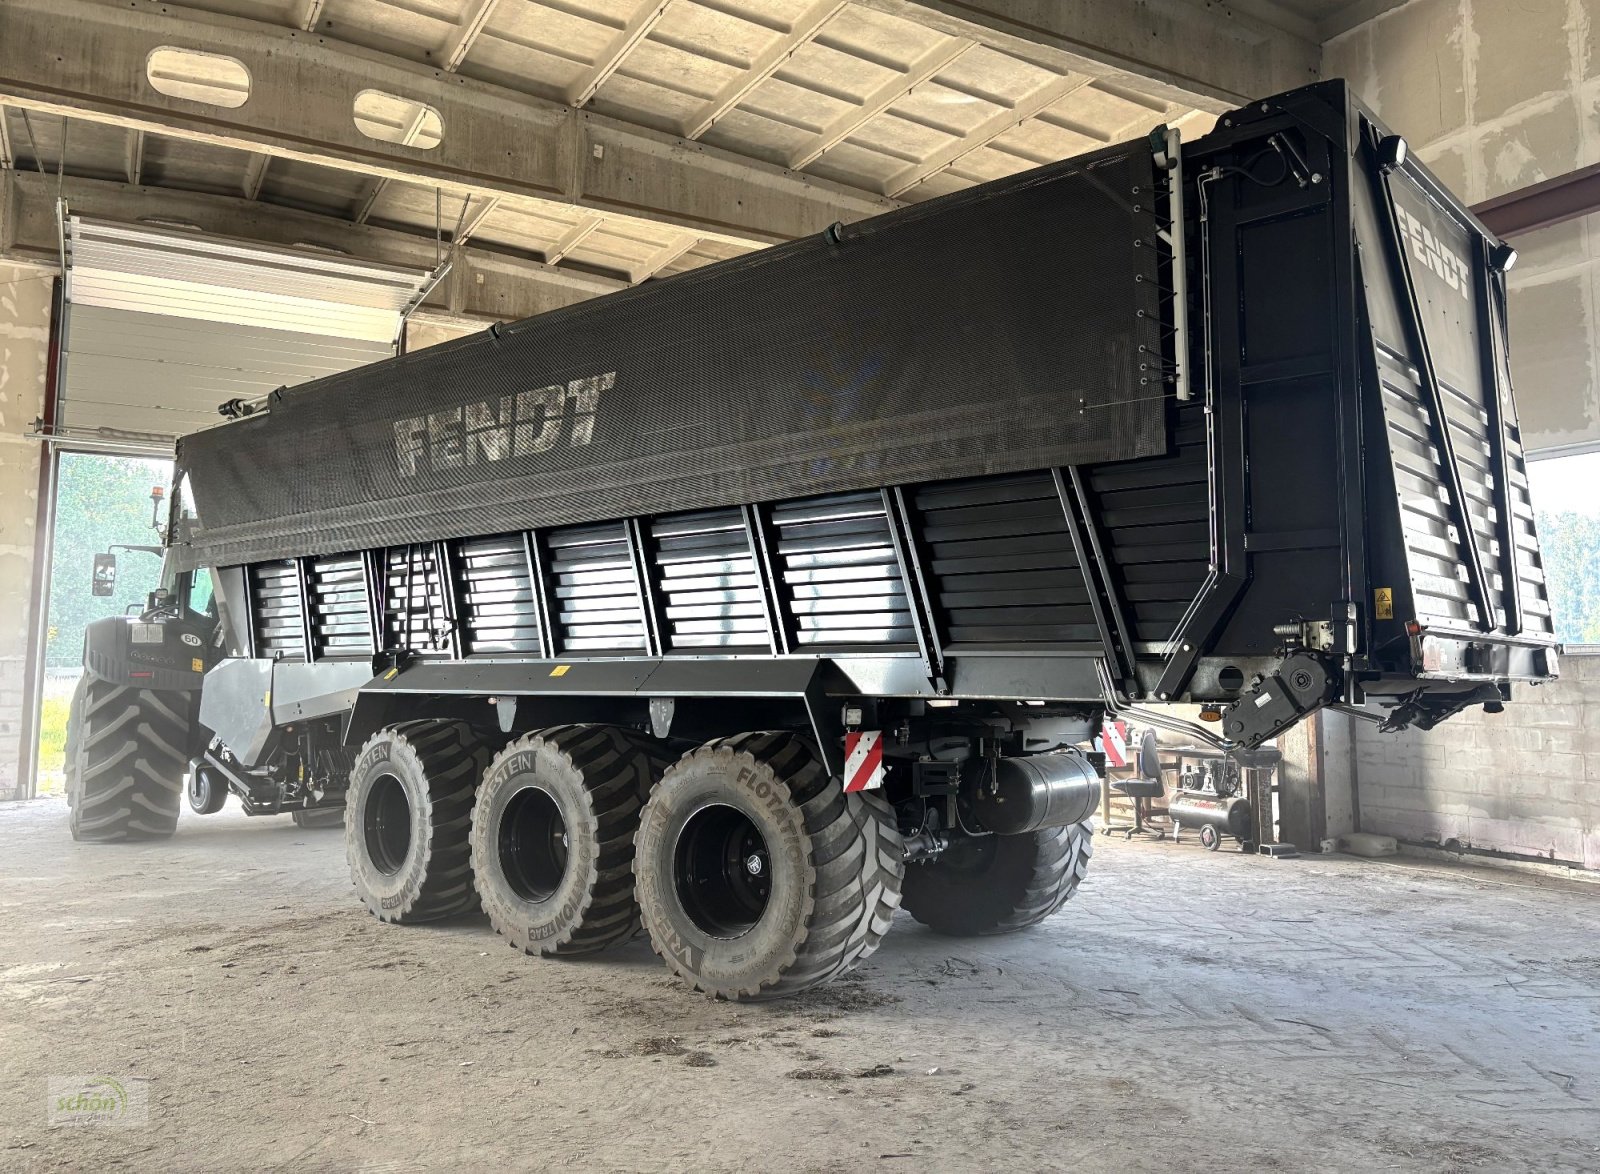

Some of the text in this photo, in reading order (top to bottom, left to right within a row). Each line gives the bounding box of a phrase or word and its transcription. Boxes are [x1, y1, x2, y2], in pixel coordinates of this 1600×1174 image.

[1394, 202, 1469, 301] FENDT
[393, 371, 616, 478] FENDT
[184, 634, 198, 645] 60
